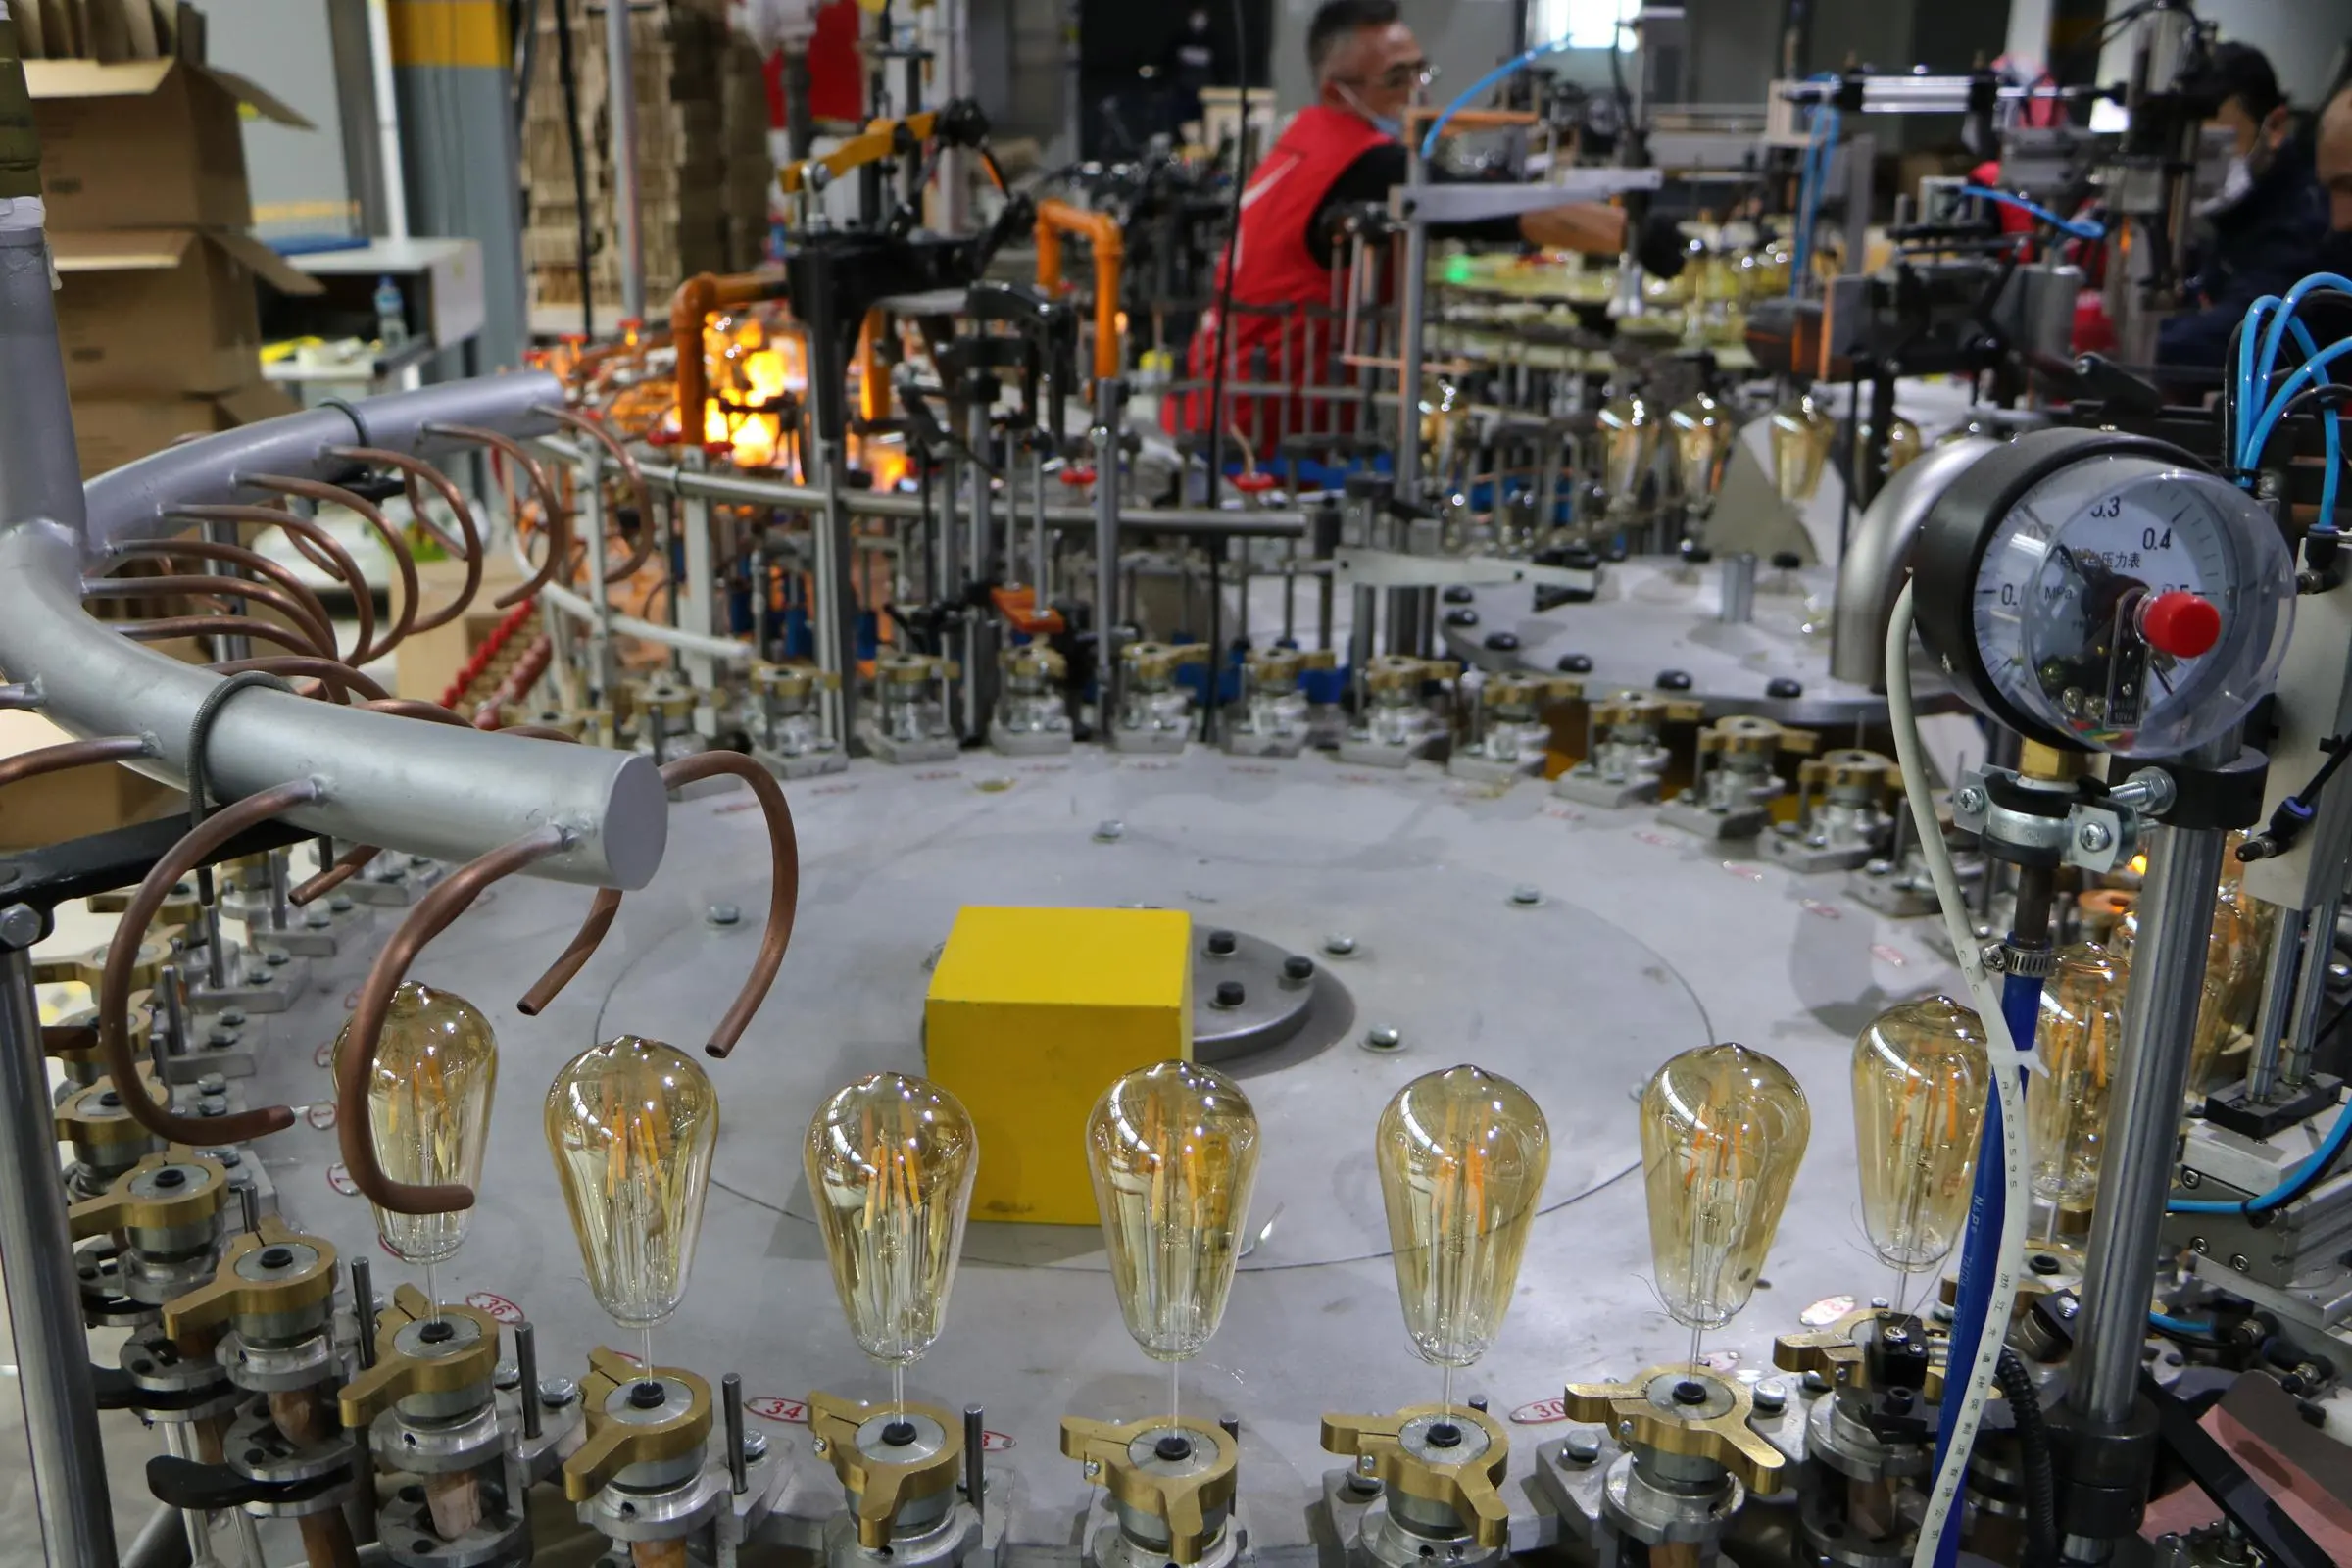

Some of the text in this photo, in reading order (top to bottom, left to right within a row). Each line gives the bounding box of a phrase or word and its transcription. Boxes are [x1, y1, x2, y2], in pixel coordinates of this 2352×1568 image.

[2142, 527, 2173, 551] 0.4
[2044, 587, 2074, 601] MPa
[479, 1298, 512, 1315] 36
[765, 1400, 804, 1418] 34
[1532, 1400, 1565, 1418] 30
